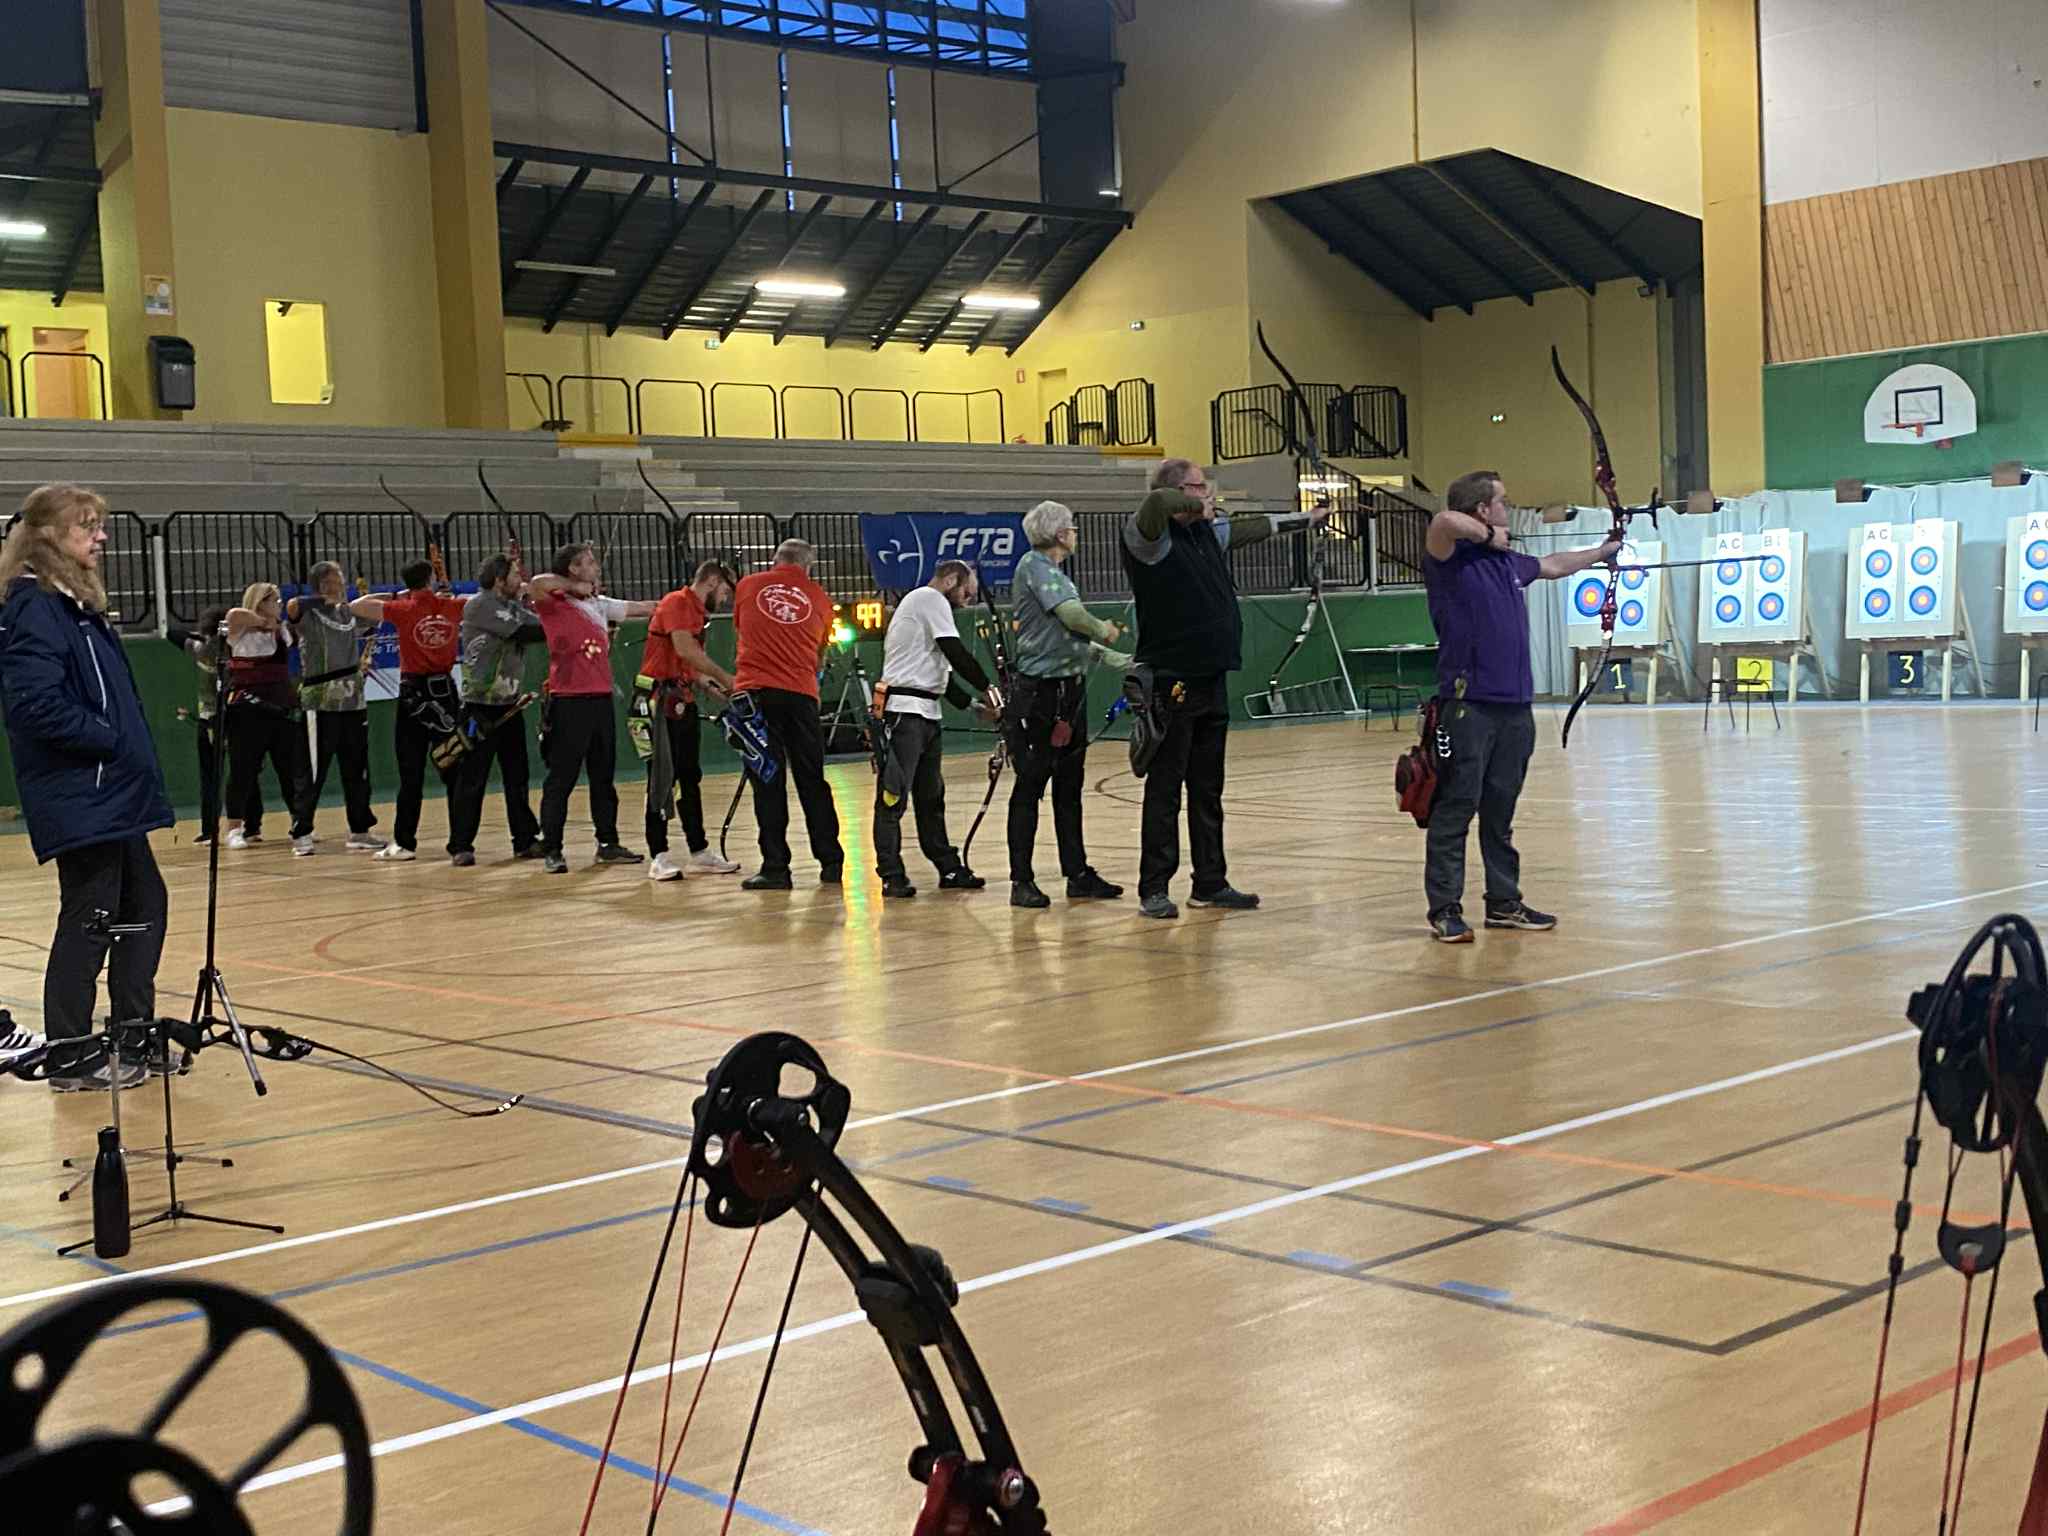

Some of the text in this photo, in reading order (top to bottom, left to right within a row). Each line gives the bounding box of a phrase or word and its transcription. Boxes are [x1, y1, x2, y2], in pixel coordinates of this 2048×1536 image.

[1610, 663, 1627, 690] 1
[1748, 660, 1763, 685] 2
[1899, 654, 1915, 684] 3
